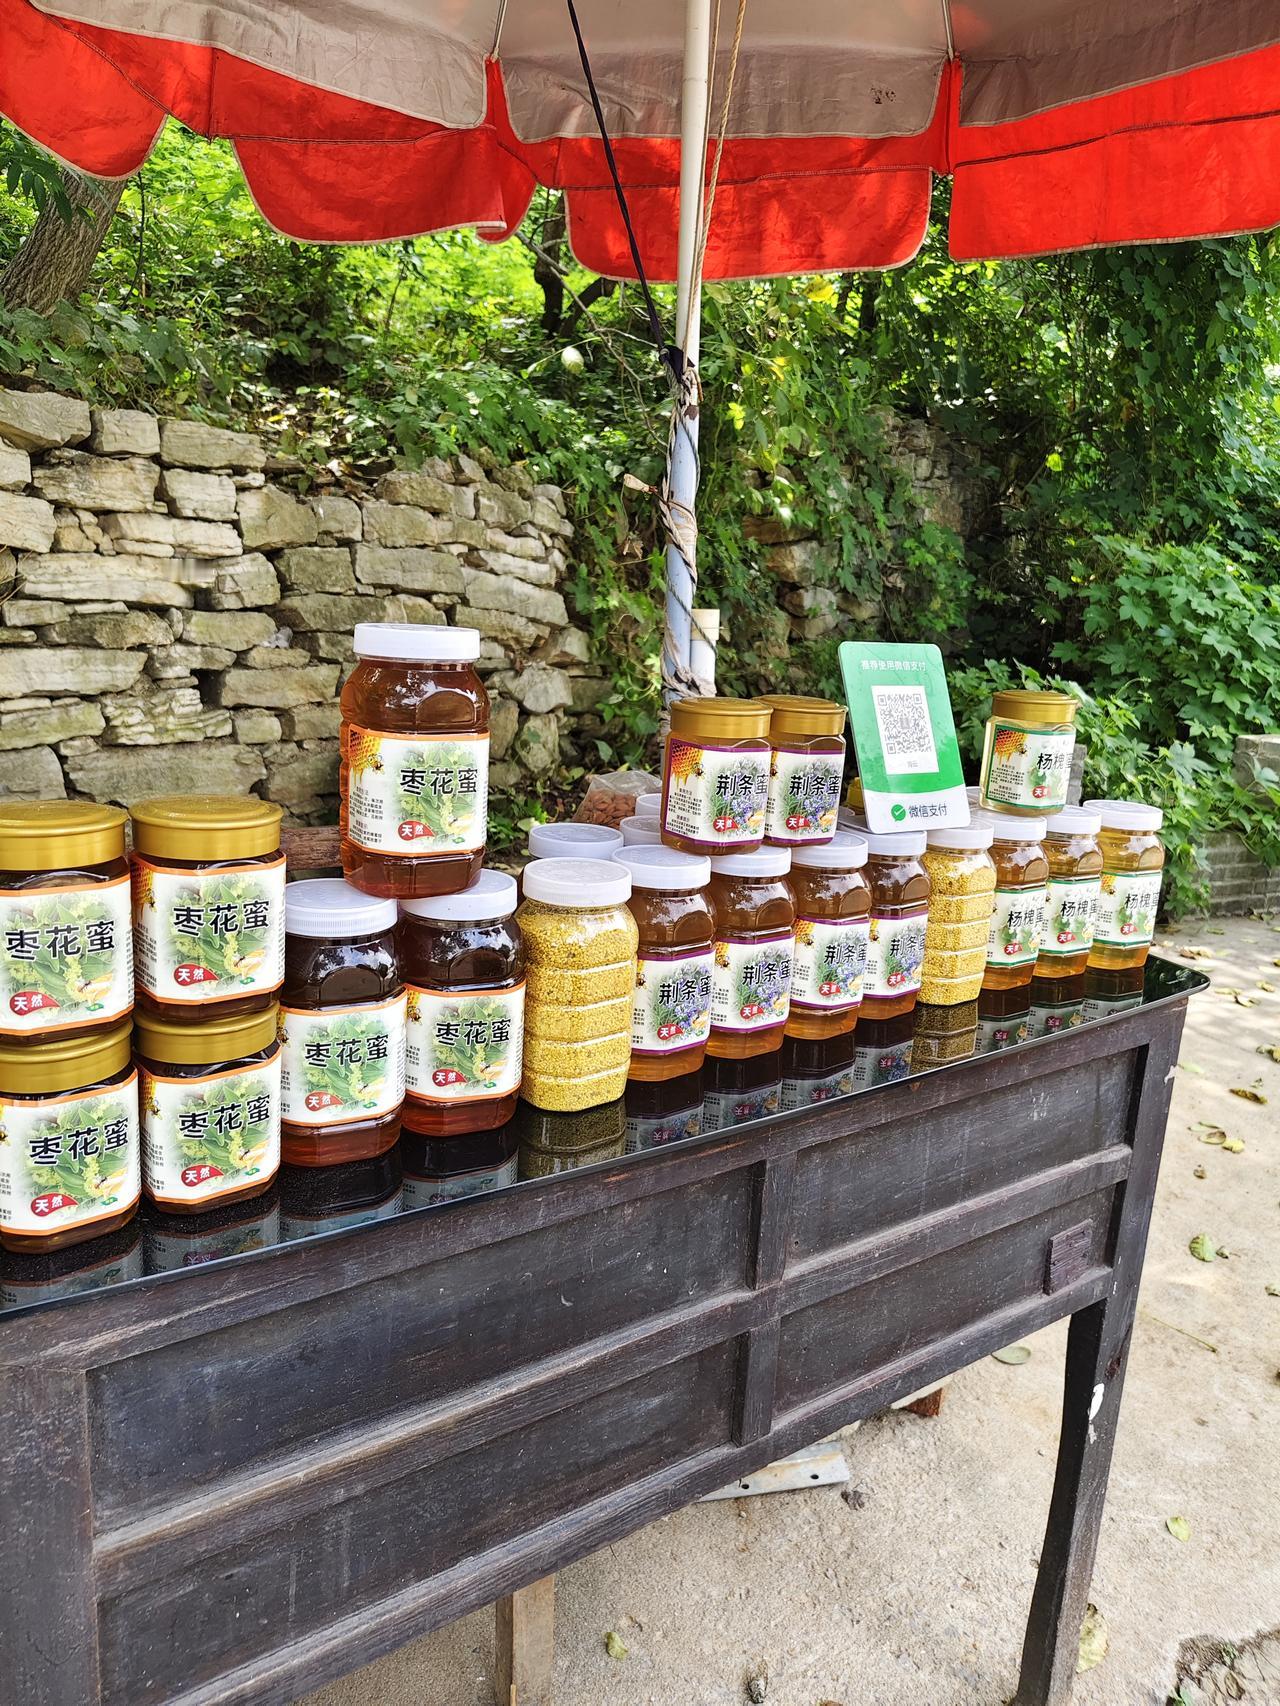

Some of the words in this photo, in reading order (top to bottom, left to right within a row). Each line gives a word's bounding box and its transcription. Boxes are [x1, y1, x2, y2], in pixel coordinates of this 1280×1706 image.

[400, 768, 478, 796] 枣花蜜
[716, 773, 769, 797] 荆条蜜
[789, 775, 841, 796] 荆条蜜
[908, 804, 947, 818] 微信支付
[401, 824, 425, 838] 天然
[173, 900, 269, 937] 枣花蜜
[5, 920, 115, 961] 枣花蜜
[824, 942, 867, 964] 荆条蜜
[178, 968, 204, 982] 天然
[742, 959, 791, 986] 荆条蜜
[659, 974, 712, 1005] 荆条蜜
[14, 993, 43, 1011] 天然
[436, 1019, 511, 1046] 枣花蜜
[305, 1034, 389, 1067] 枣花蜜
[436, 1072, 456, 1084] 天然
[308, 1095, 331, 1108] 天然
[179, 1094, 270, 1139] 枣花蜜
[29, 1117, 129, 1165] 枣花蜜
[185, 1167, 210, 1183] 天然
[35, 1196, 63, 1213] 天然
